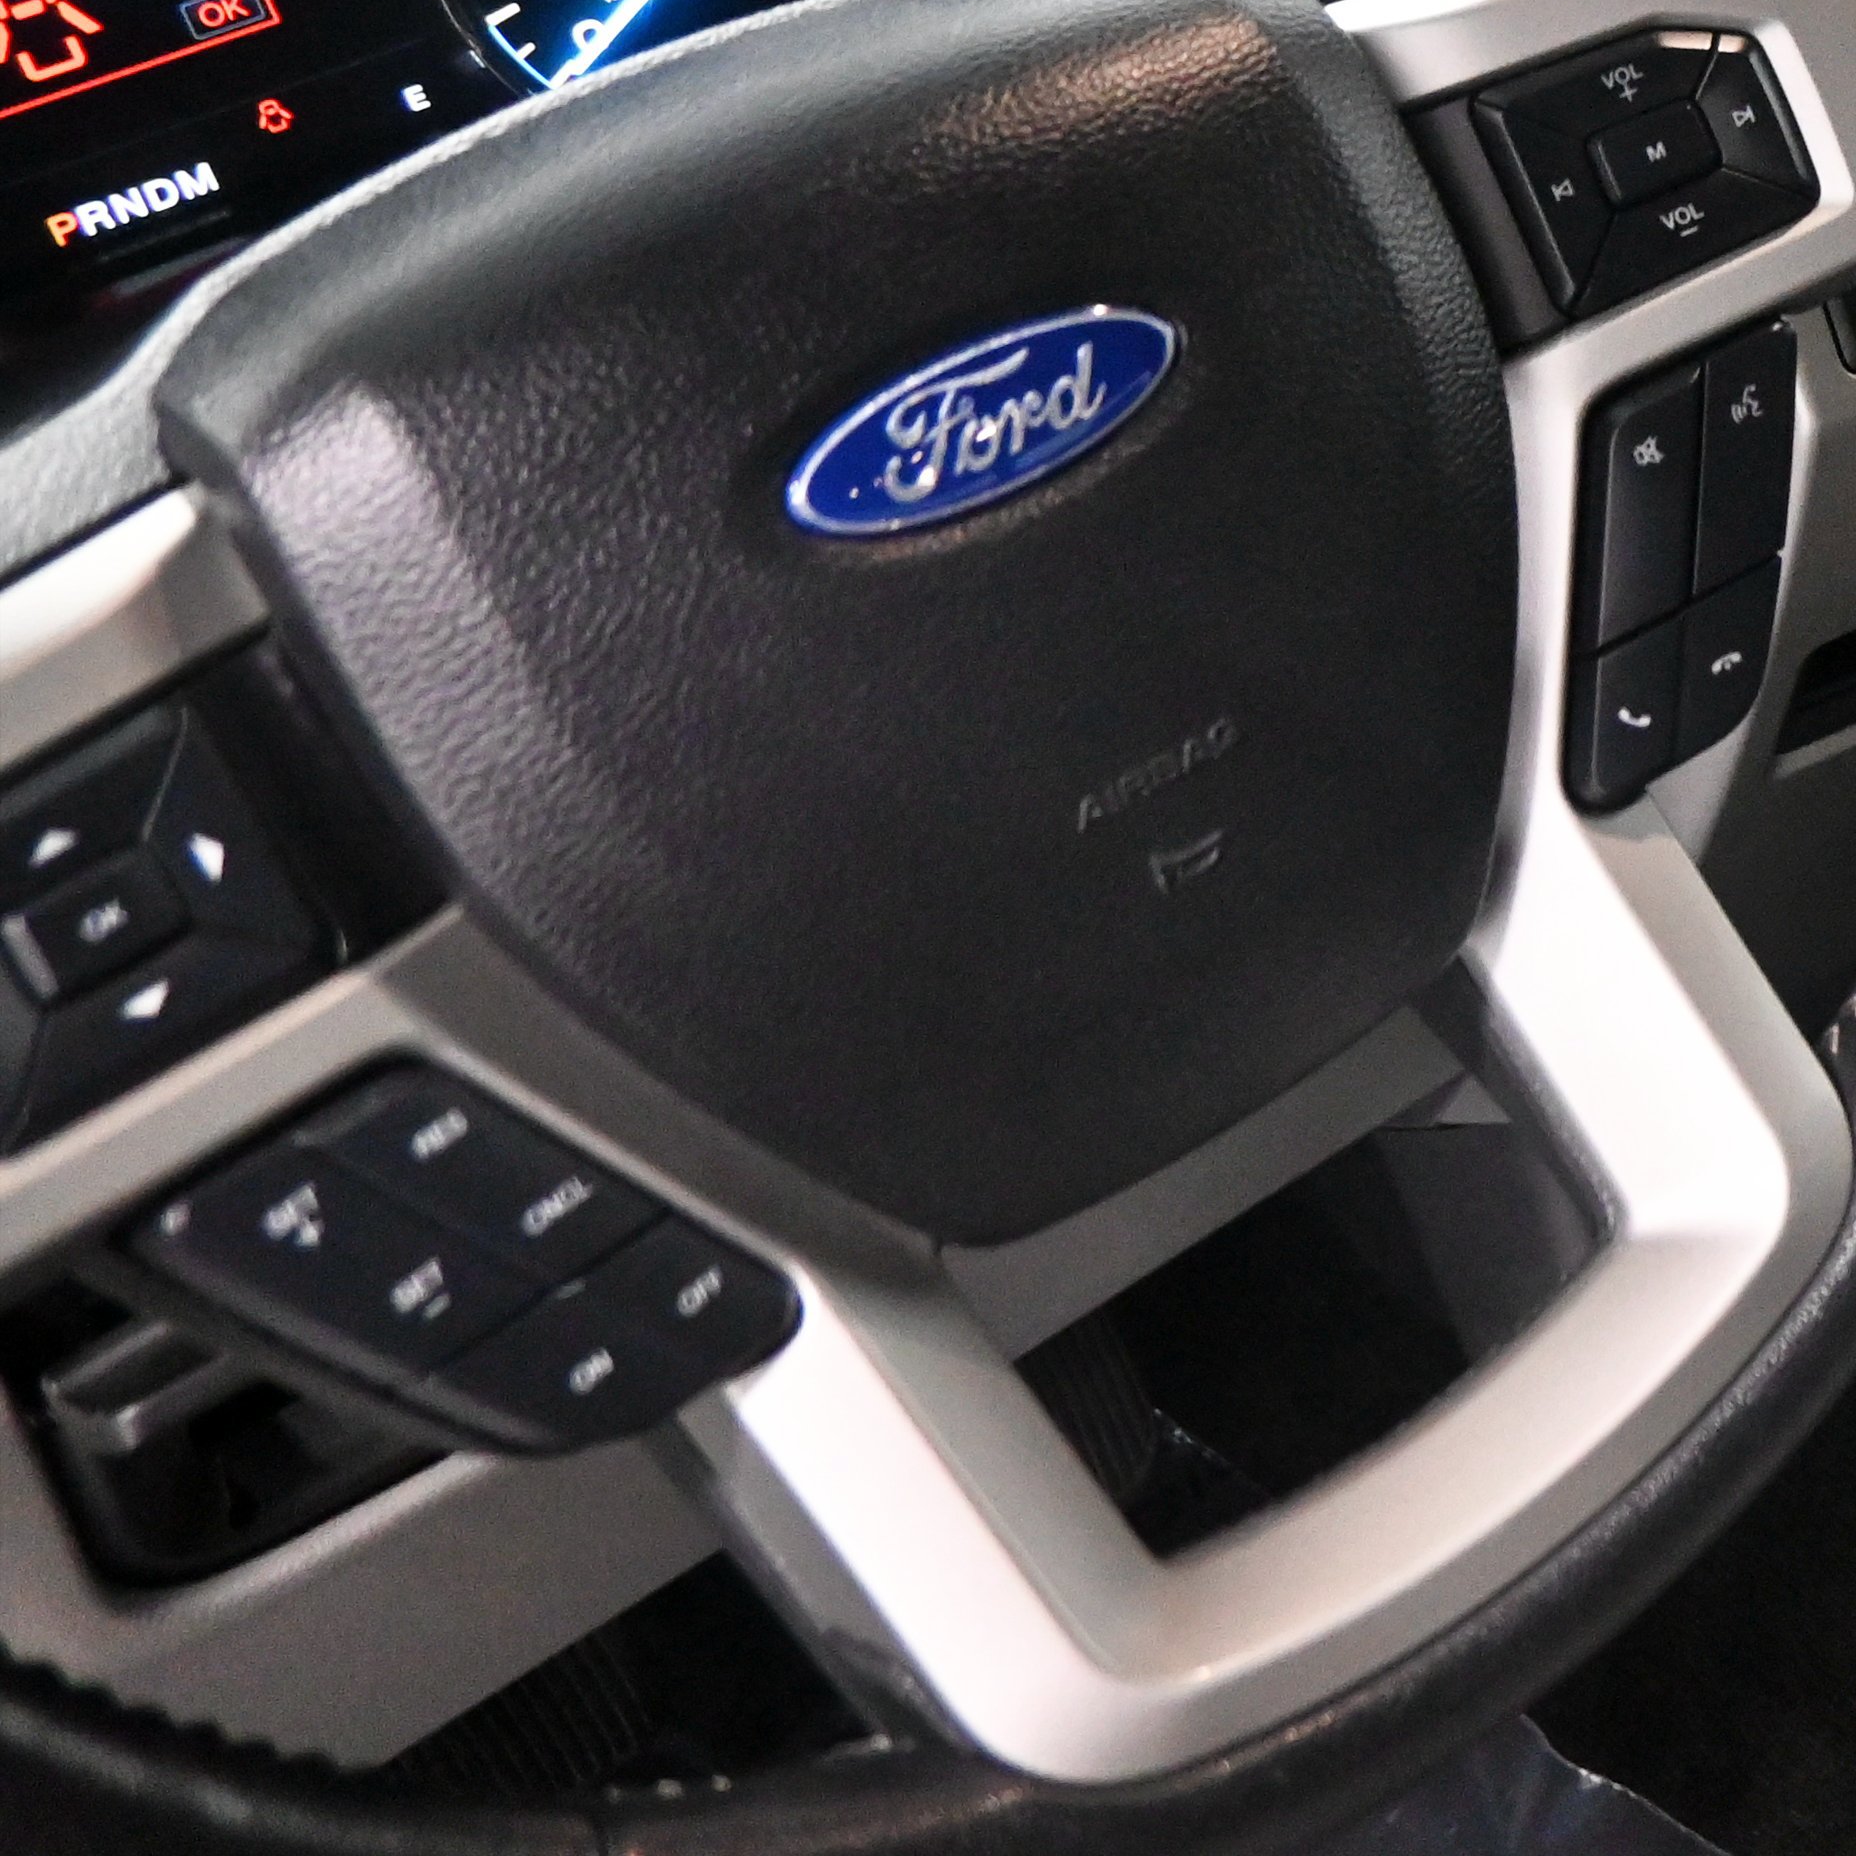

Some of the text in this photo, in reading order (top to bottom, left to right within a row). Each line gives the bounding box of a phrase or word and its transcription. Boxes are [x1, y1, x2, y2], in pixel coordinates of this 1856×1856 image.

[1601, 62, 1645, 90] VOL
[402, 83, 431, 113] E
[1645, 141, 1668, 162] M
[44, 161, 221, 247] PRNDM
[1659, 201, 1705, 231] VOL
[885, 341, 1106, 501] Ford
